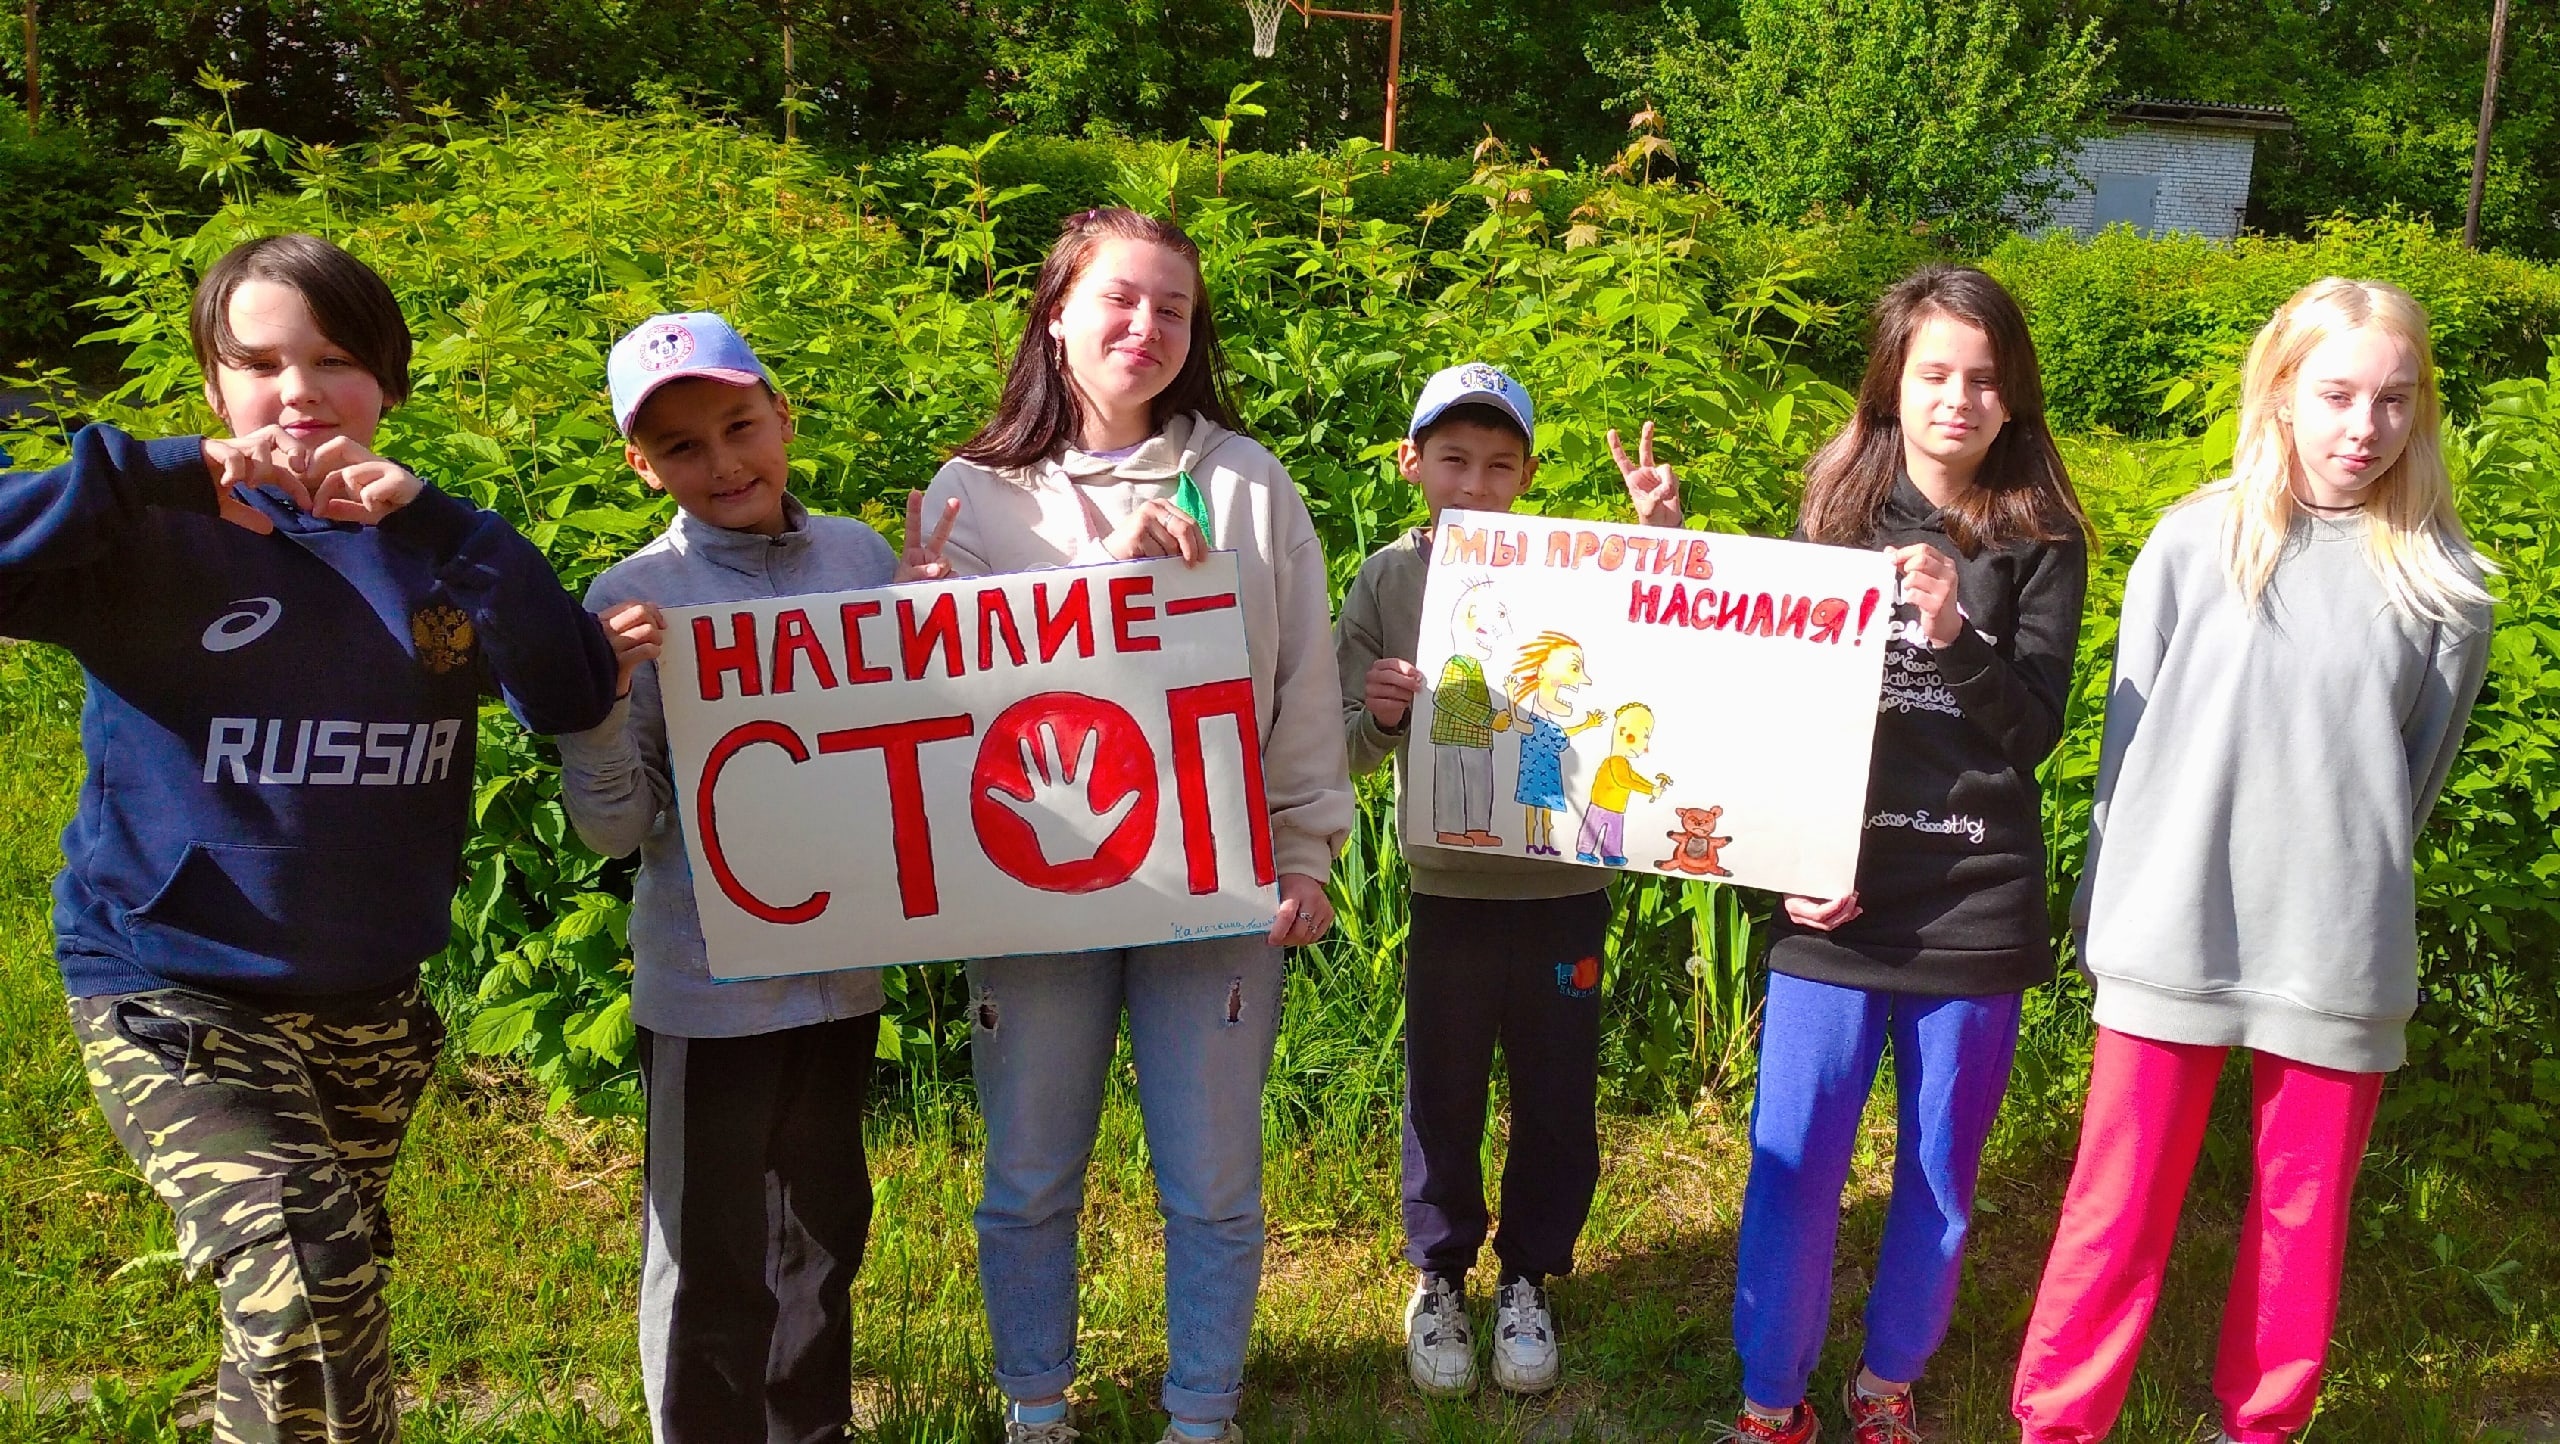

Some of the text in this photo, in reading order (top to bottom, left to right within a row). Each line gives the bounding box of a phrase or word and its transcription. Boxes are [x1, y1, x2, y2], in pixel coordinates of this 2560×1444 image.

[1441, 524, 1714, 580] МЫ ПРОТИВ
[1628, 579, 1881, 647] НАСИЛИЯ!
[203, 717, 462, 785] RUSSIA
[696, 677, 1276, 925] СТОП
